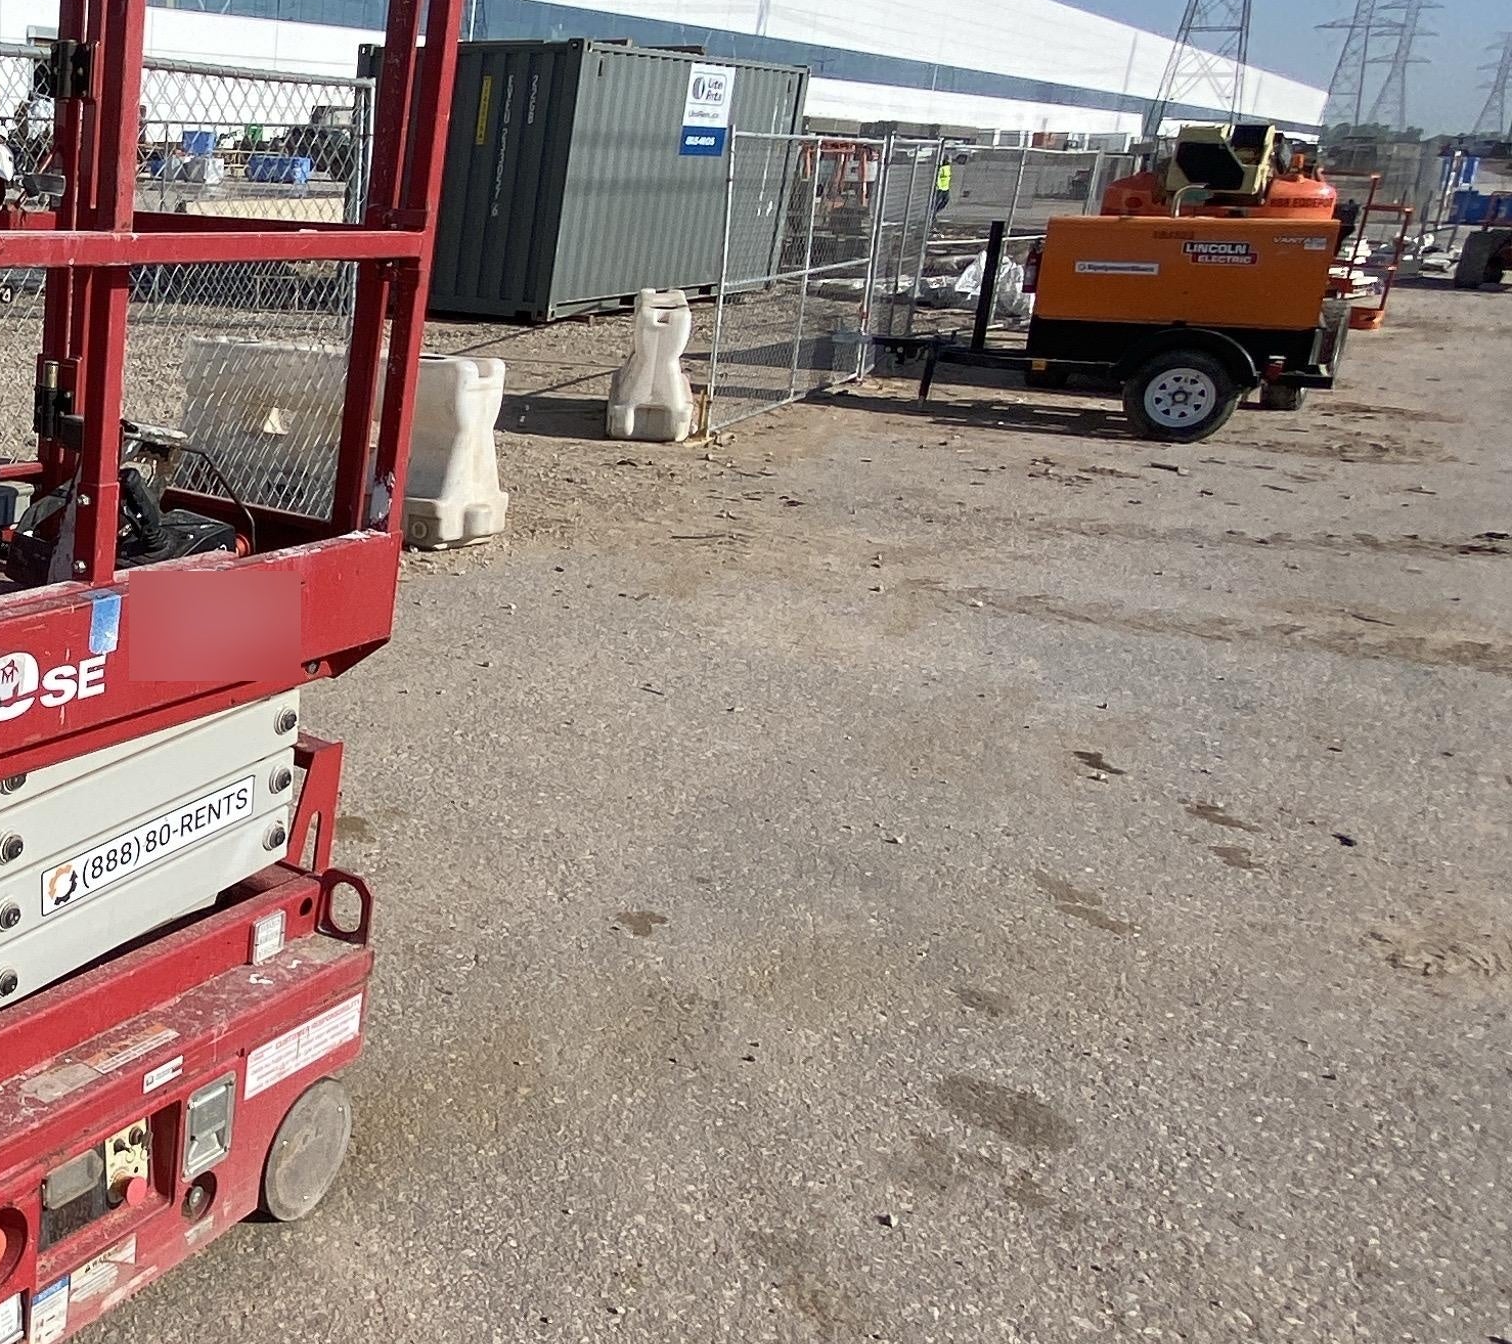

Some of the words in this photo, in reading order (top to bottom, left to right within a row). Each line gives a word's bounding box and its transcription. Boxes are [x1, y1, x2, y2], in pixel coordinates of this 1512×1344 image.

[1185, 242, 1248, 255] LINCOLN
[1196, 254, 1254, 265] ELECTRIC
[83, 836, 141, 889] (888)
[145, 787, 249, 854] 80-RENTS
